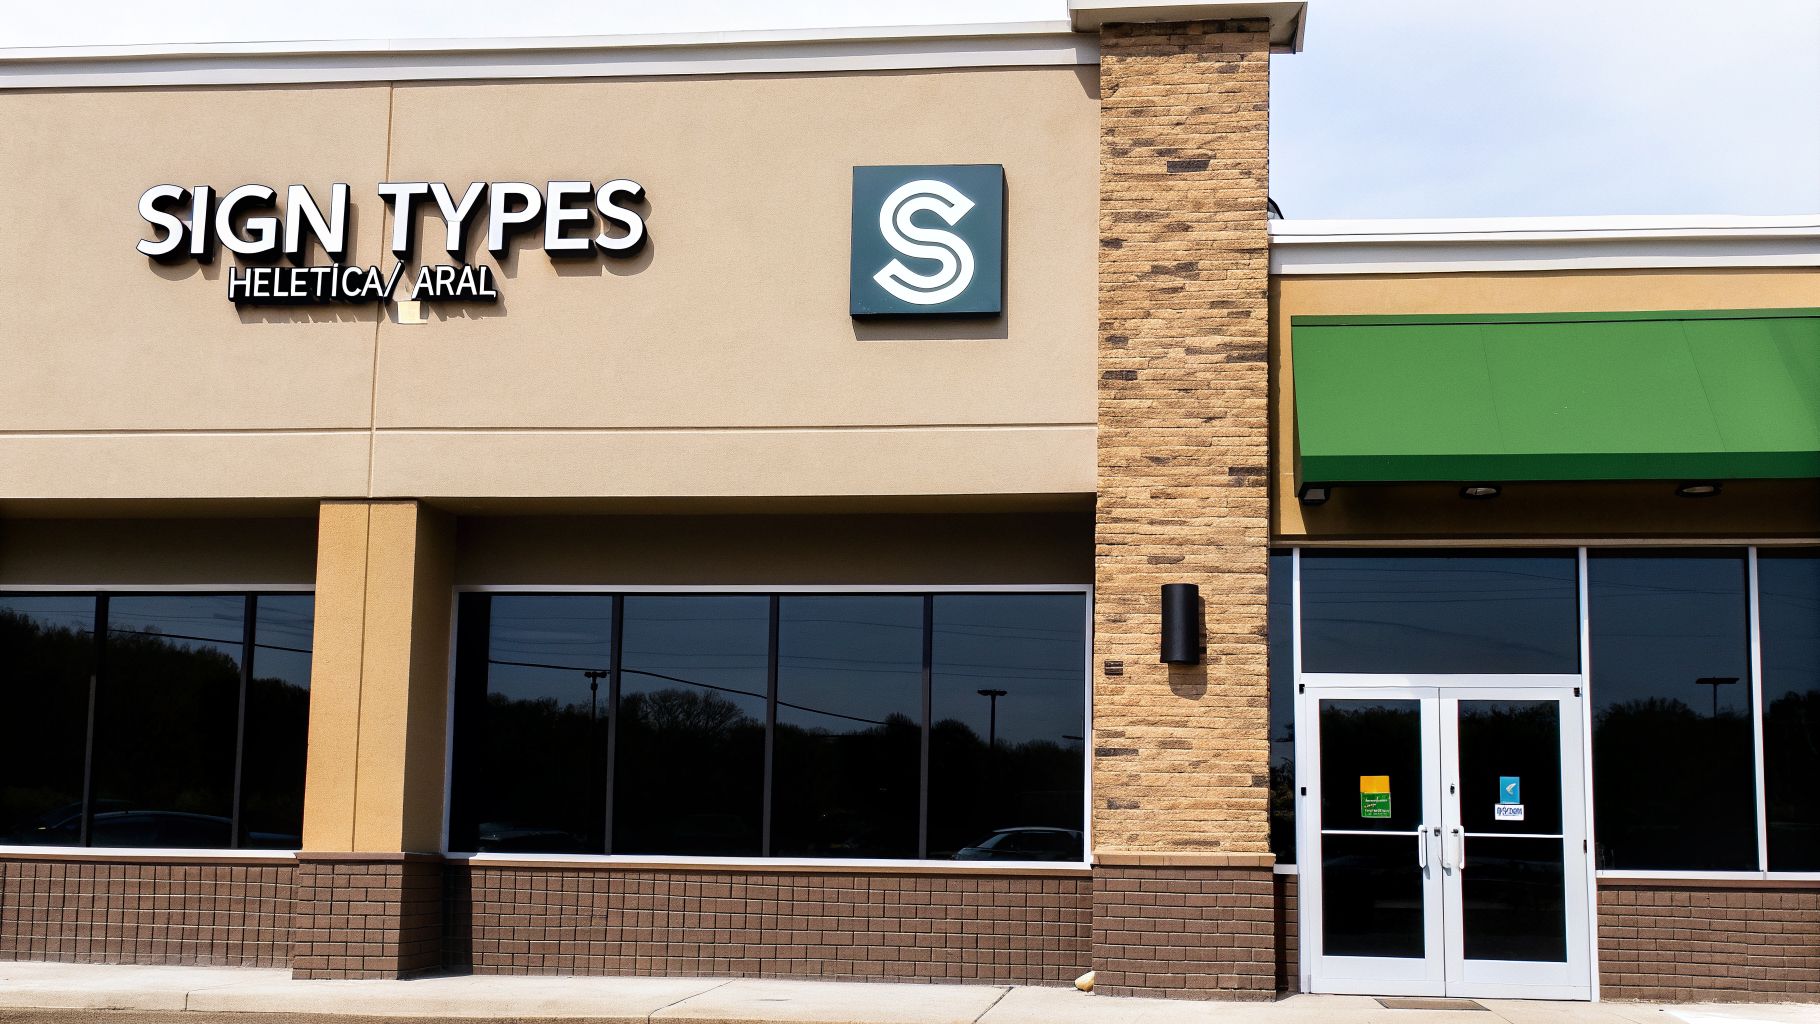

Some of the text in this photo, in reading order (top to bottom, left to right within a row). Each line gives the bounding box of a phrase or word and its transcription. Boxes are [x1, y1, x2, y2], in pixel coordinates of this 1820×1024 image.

[136, 178, 646, 257] SIGN TYPES
[873, 179, 976, 305] S
[411, 265, 497, 299] ARAL
